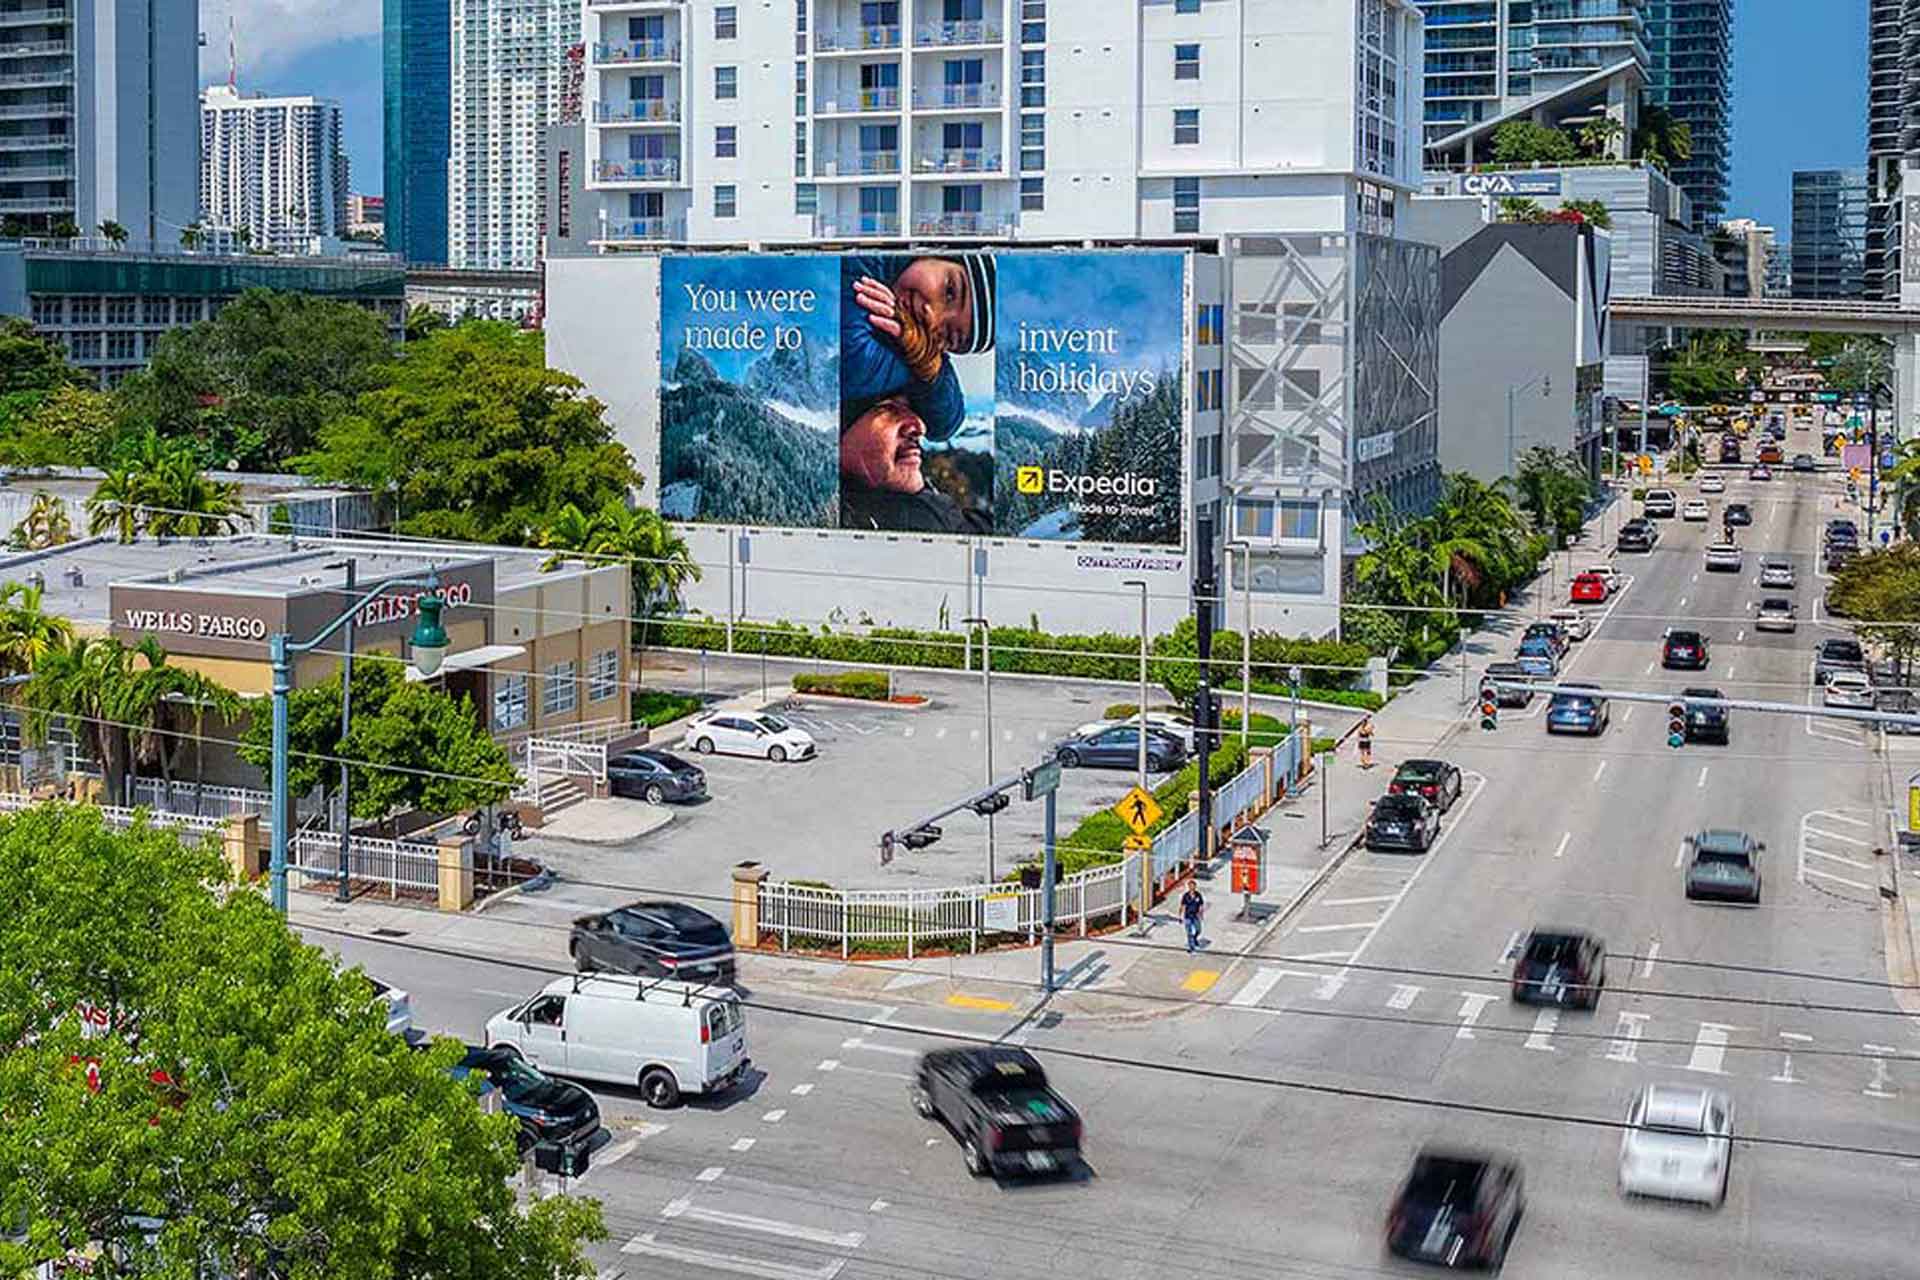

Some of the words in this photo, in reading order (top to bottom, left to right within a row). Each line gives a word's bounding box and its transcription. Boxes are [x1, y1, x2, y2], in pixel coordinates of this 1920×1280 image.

[683, 284, 737, 312] You
[746, 289, 816, 312] were
[685, 321, 766, 350] made
[775, 325, 802, 349] to
[1020, 321, 1119, 352] invent
[1020, 361, 1156, 401] holidays
[1049, 470, 1157, 496] Expedia
[1069, 502, 1102, 514] Made
[1105, 505, 1118, 515] to
[125, 609, 192, 633] WELLS
[199, 615, 266, 638] FARGO
